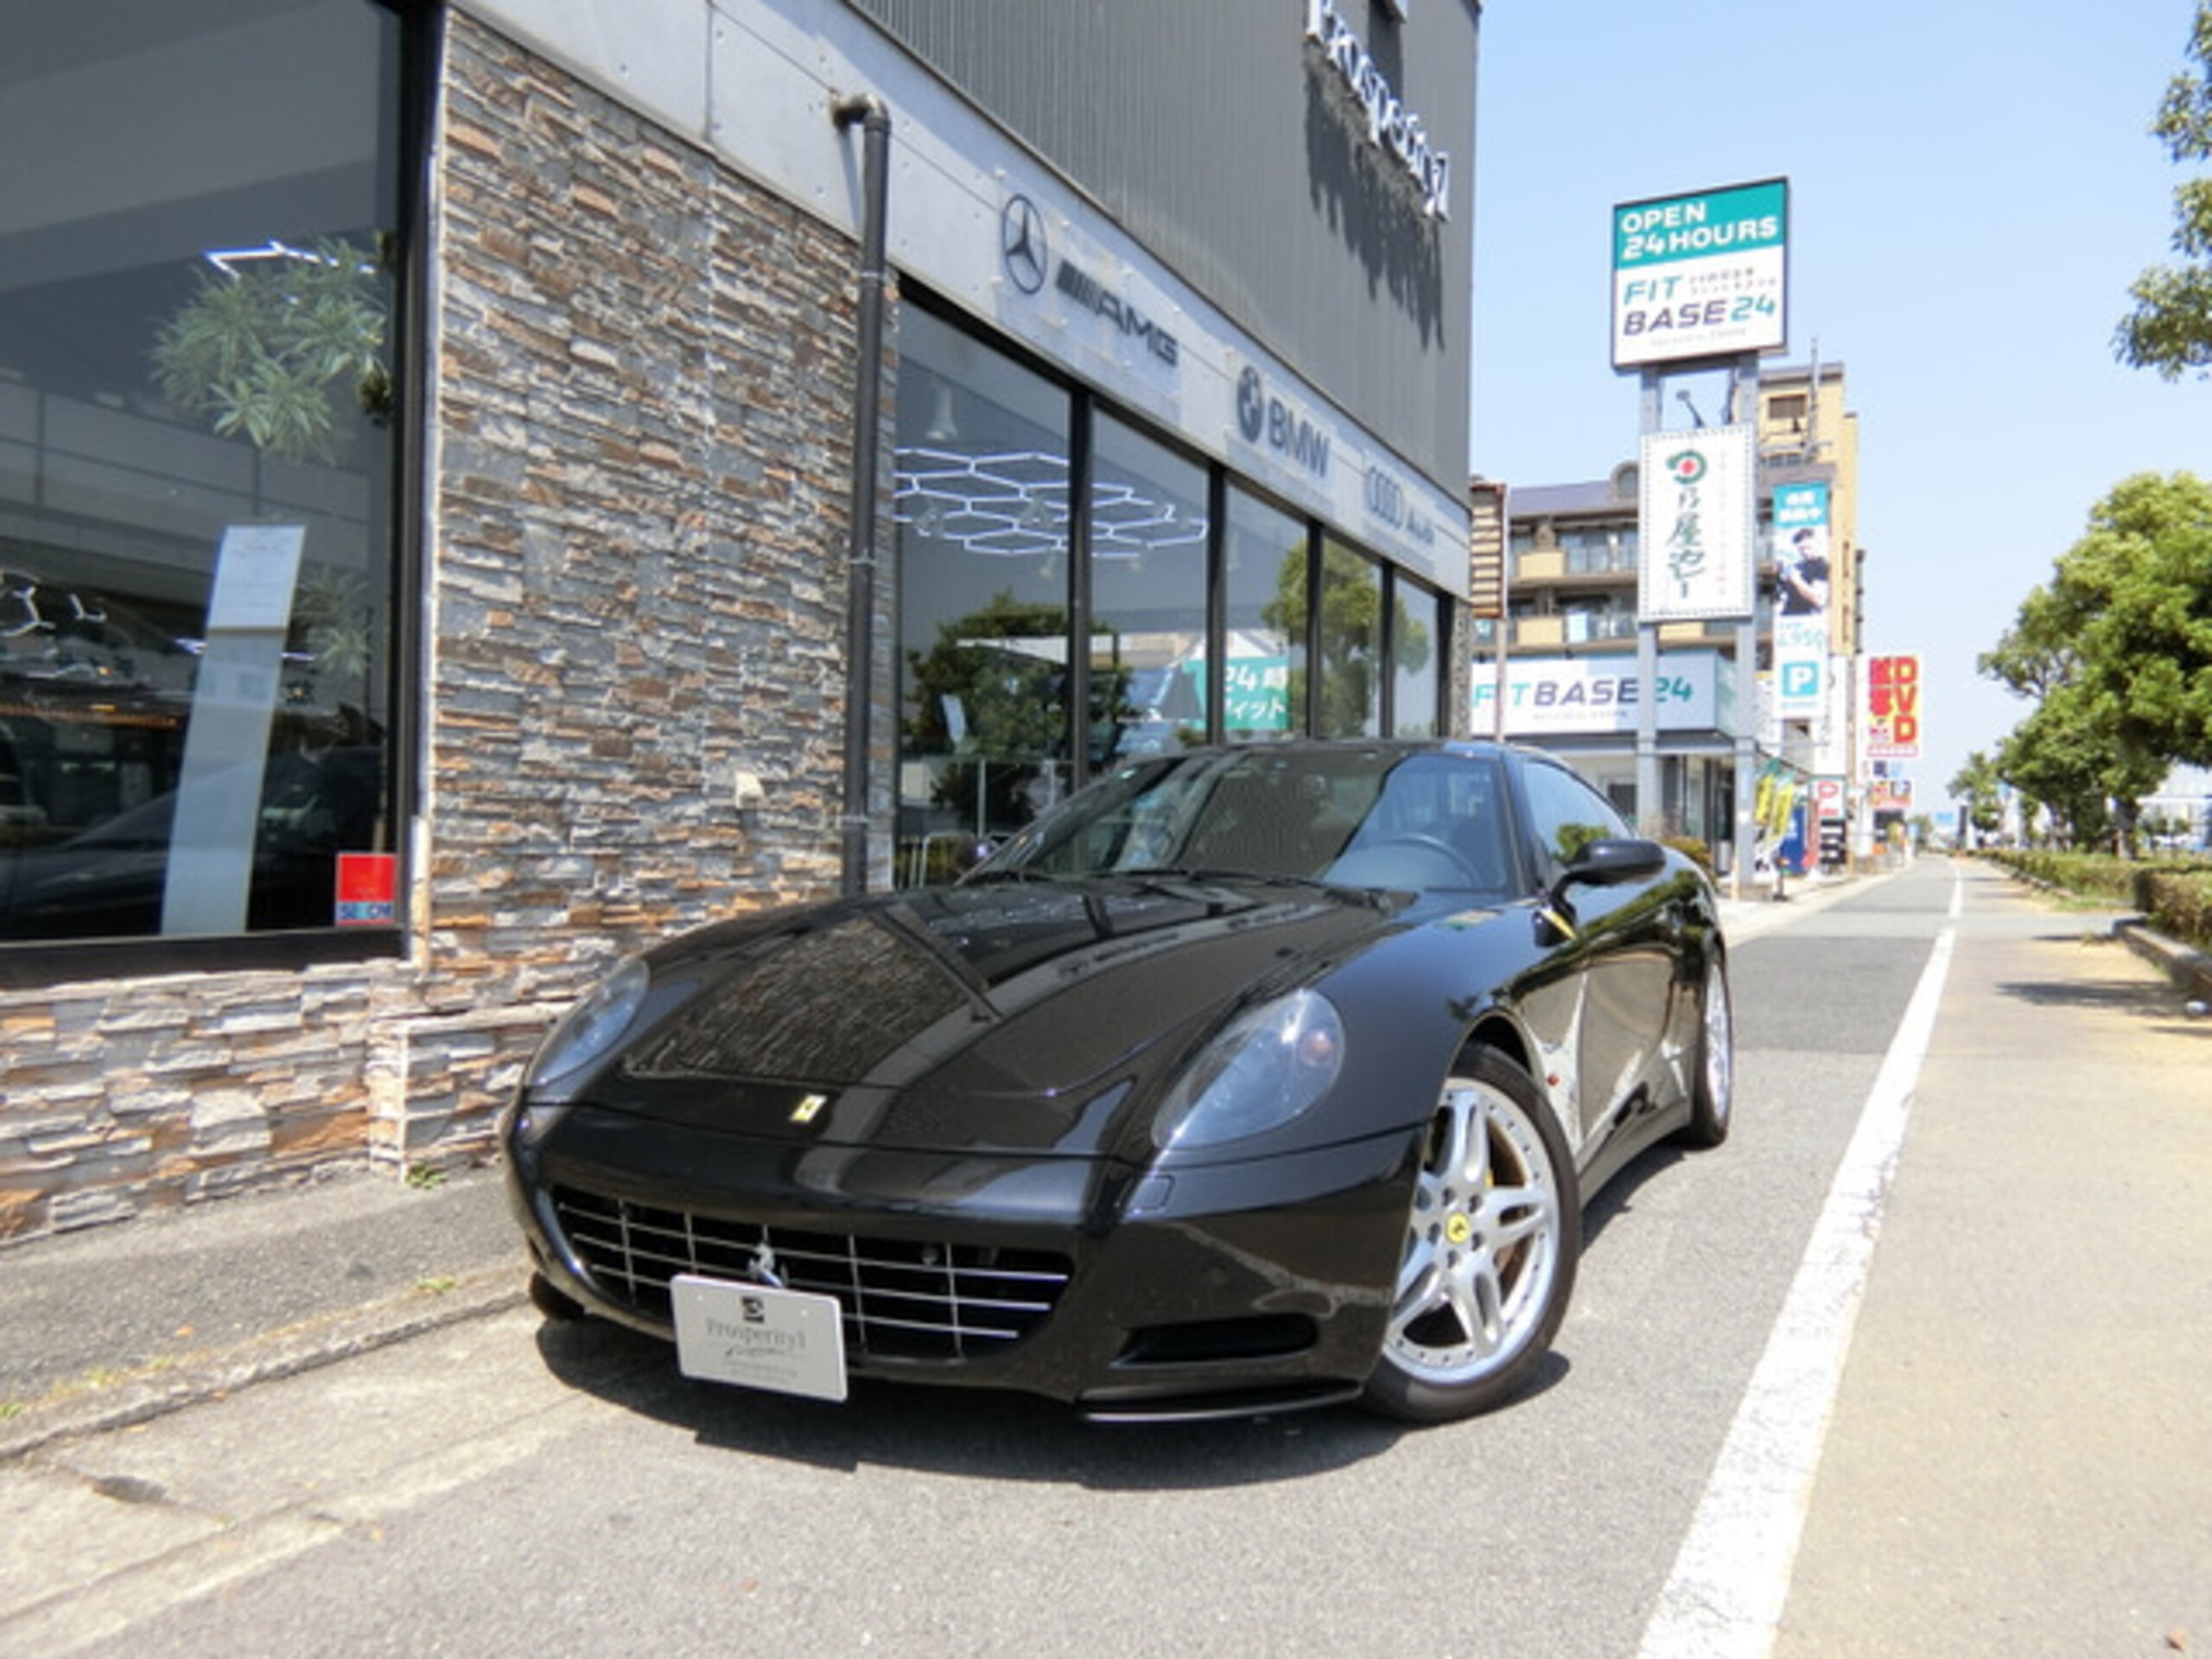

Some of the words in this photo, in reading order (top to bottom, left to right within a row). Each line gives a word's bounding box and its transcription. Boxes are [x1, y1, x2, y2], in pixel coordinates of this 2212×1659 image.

[1621, 201, 1707, 233] OPEN
[1624, 276, 1682, 306] FIT
[1268, 397, 1330, 477] BMW
[1789, 665, 1813, 692] P
[1894, 657, 1917, 743] DVD
